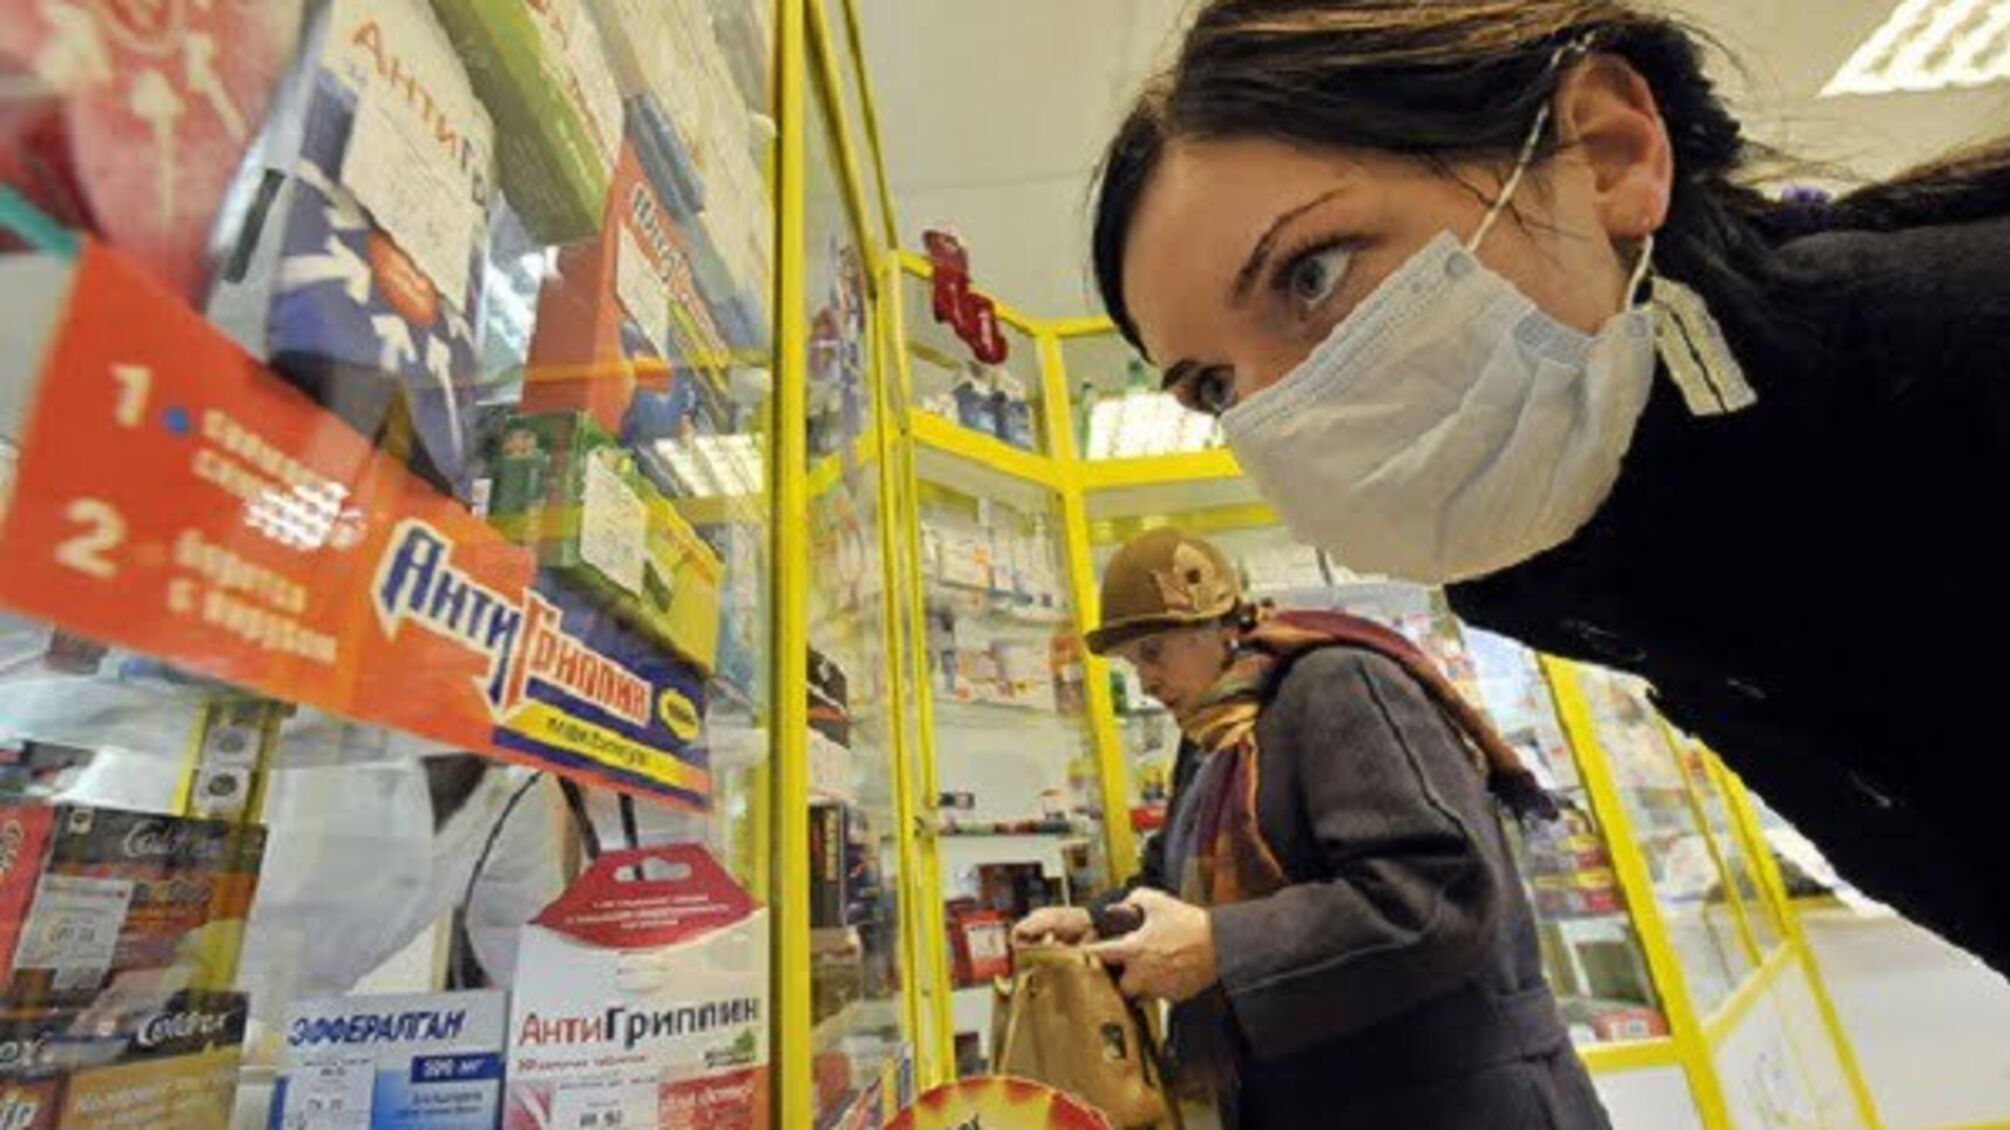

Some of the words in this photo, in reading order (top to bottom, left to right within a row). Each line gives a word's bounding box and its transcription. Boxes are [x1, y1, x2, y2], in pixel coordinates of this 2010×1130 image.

[109, 364, 152, 426] 1
[54, 500, 126, 578] 2
[373, 519, 652, 727] АнтиГриппин
[287, 1009, 467, 1047] ЭФФЕРАЛГАН
[519, 998, 760, 1050] АнтиГриппин
